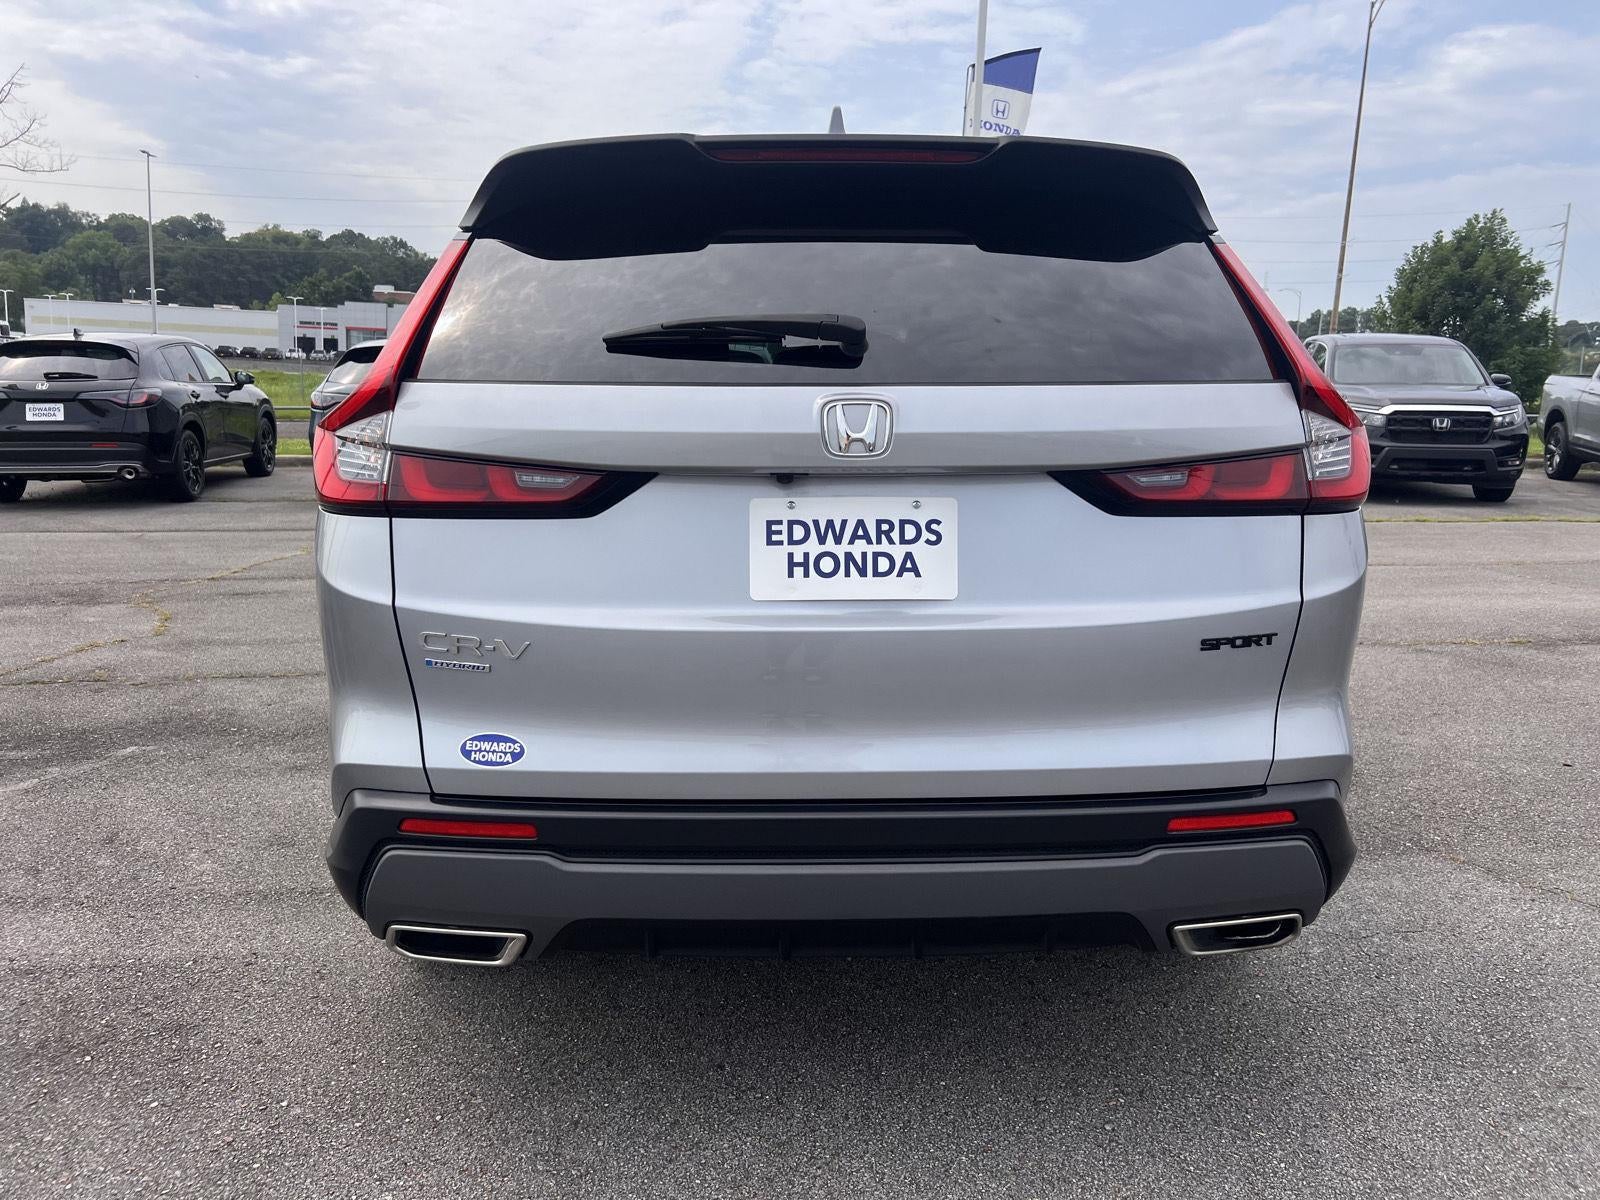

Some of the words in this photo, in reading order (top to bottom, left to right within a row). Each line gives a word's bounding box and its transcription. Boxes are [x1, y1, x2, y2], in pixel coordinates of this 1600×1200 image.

[765, 518, 943, 546] EDWARDS
[786, 550, 922, 579] HONDA
[419, 630, 531, 660] CR-V
[1200, 632, 1279, 651] SPORT
[433, 660, 486, 672] HYBRID
[465, 740, 521, 753] EDWARDS
[470, 751, 513, 764] HONDA
